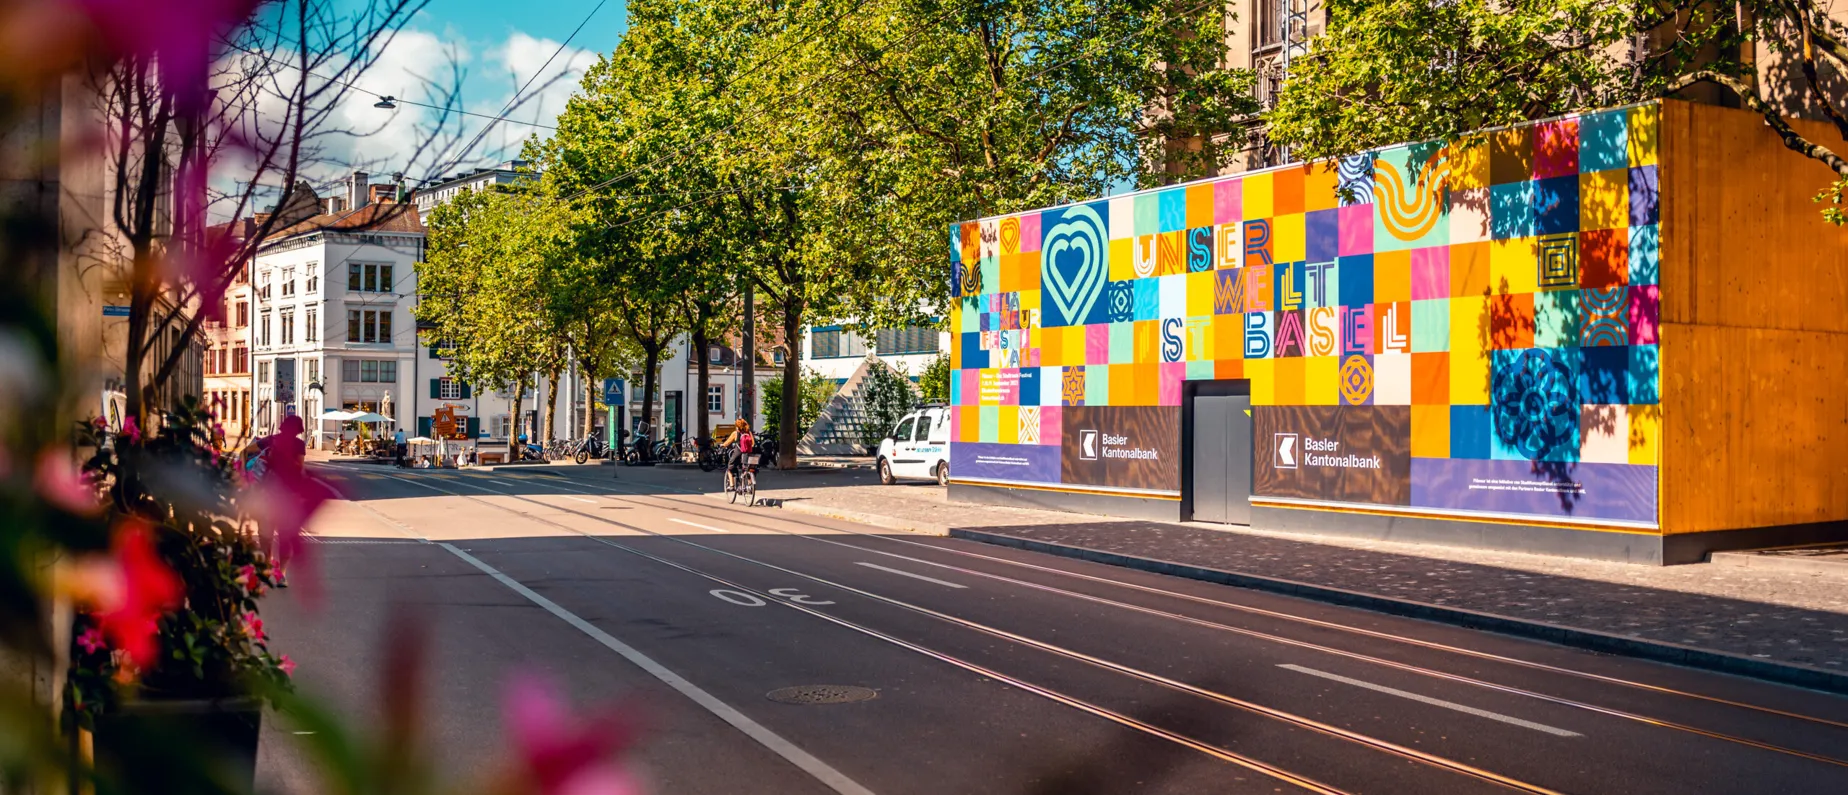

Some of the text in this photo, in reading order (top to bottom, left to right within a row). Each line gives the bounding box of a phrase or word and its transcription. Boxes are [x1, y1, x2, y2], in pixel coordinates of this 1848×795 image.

[1133, 219, 1273, 278] UNSER
[1214, 259, 1335, 314] WELT
[1243, 302, 1407, 359] BASEL
[1102, 433, 1128, 446] Basler
[1304, 438, 1339, 452] Basler
[1102, 446, 1158, 460] Kantonalbank
[1304, 453, 1381, 469] Kantonalbank
